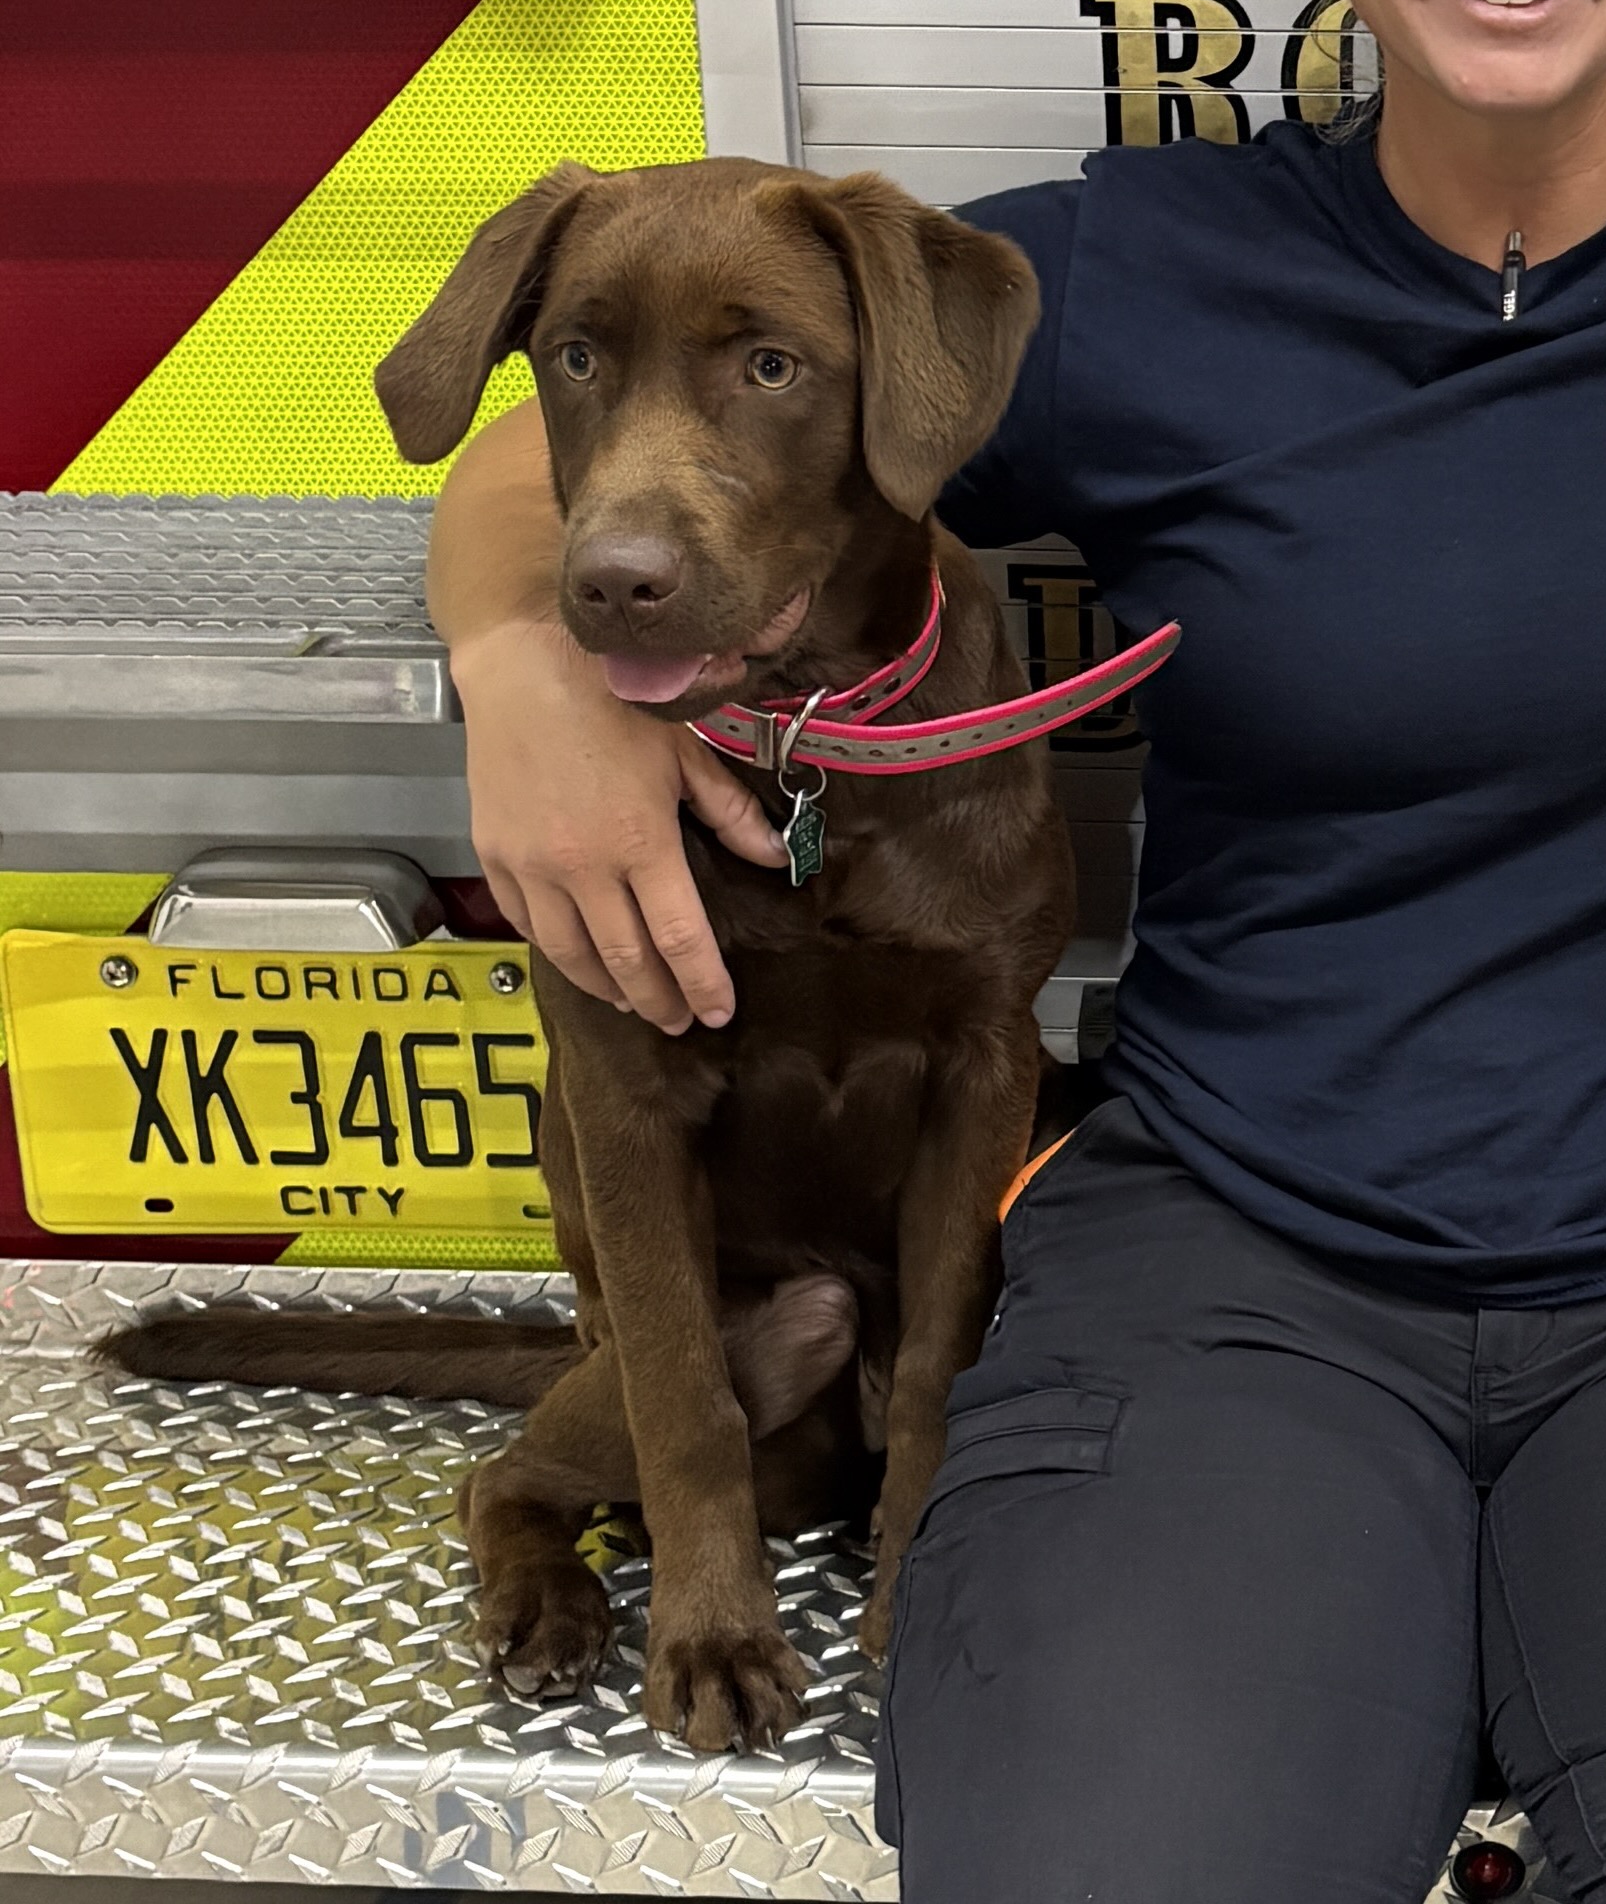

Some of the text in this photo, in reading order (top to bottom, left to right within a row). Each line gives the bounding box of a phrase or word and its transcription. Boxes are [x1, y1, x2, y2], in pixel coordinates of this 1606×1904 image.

[167, 963, 463, 1001] FLORIDA
[109, 1027, 542, 1168] XK3465
[279, 1185, 405, 1217] CITY
